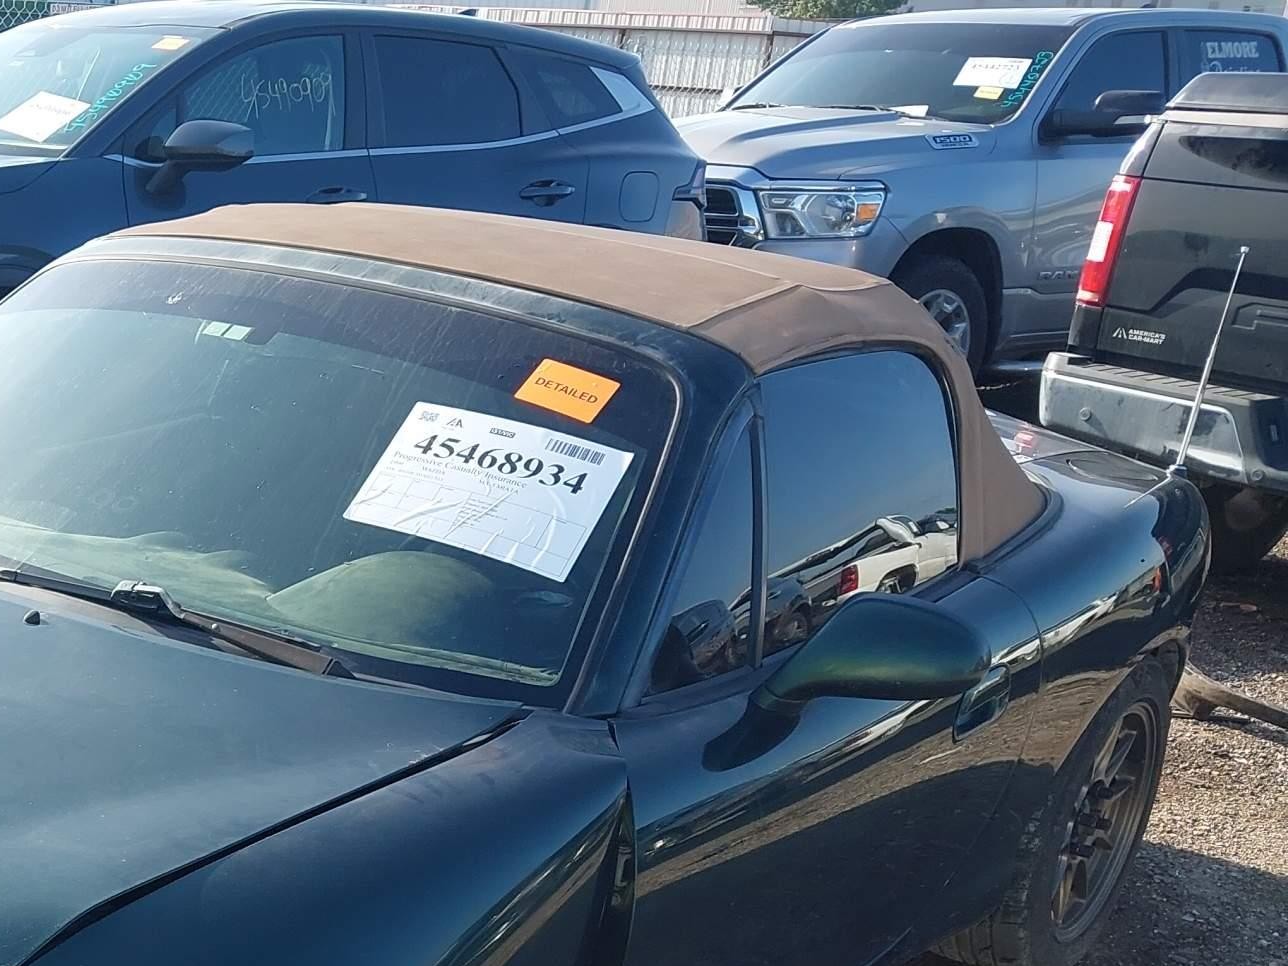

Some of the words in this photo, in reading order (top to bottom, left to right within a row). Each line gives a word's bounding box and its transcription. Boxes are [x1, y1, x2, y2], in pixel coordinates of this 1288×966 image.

[1206, 41, 1260, 58] ELMORE
[241, 72, 336, 122] 45490909
[934, 135, 970, 143] 1500
[1128, 329, 1166, 340] AMERICA'S
[1128, 334, 1164, 344] CAR-MART
[534, 377, 598, 404] DETAILED
[394, 450, 443, 467] Progressive
[445, 462, 482, 477] Casualty
[484, 471, 527, 488] Insurance
[413, 434, 589, 495] 45468934
